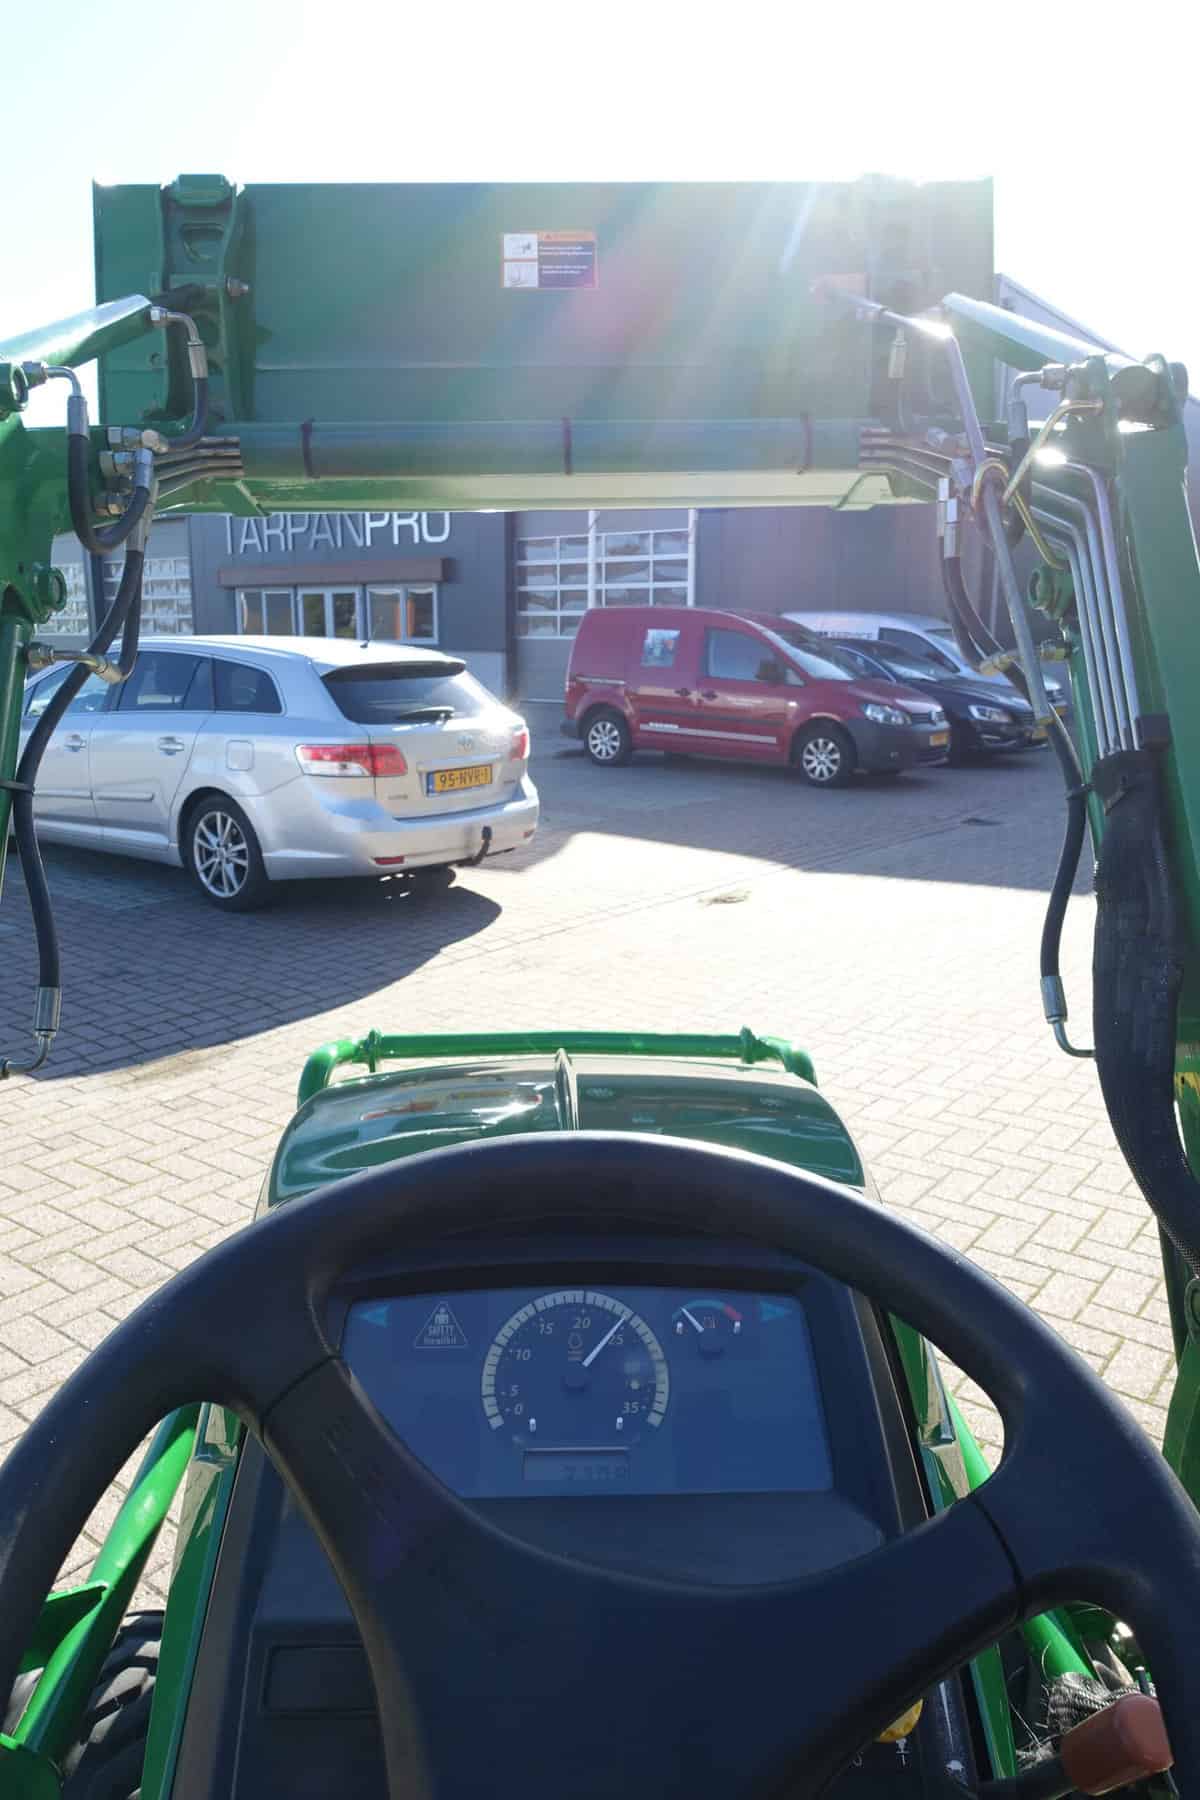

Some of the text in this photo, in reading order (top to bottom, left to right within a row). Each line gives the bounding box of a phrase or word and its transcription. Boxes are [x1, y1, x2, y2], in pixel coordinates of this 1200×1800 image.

[573, 1317, 591, 1329] 20
[608, 1334, 624, 1345] 25
[516, 1349, 531, 1361] 10
[510, 1384, 520, 1397] 5
[514, 1403, 523, 1415] 0
[622, 1401, 639, 1414] 35
